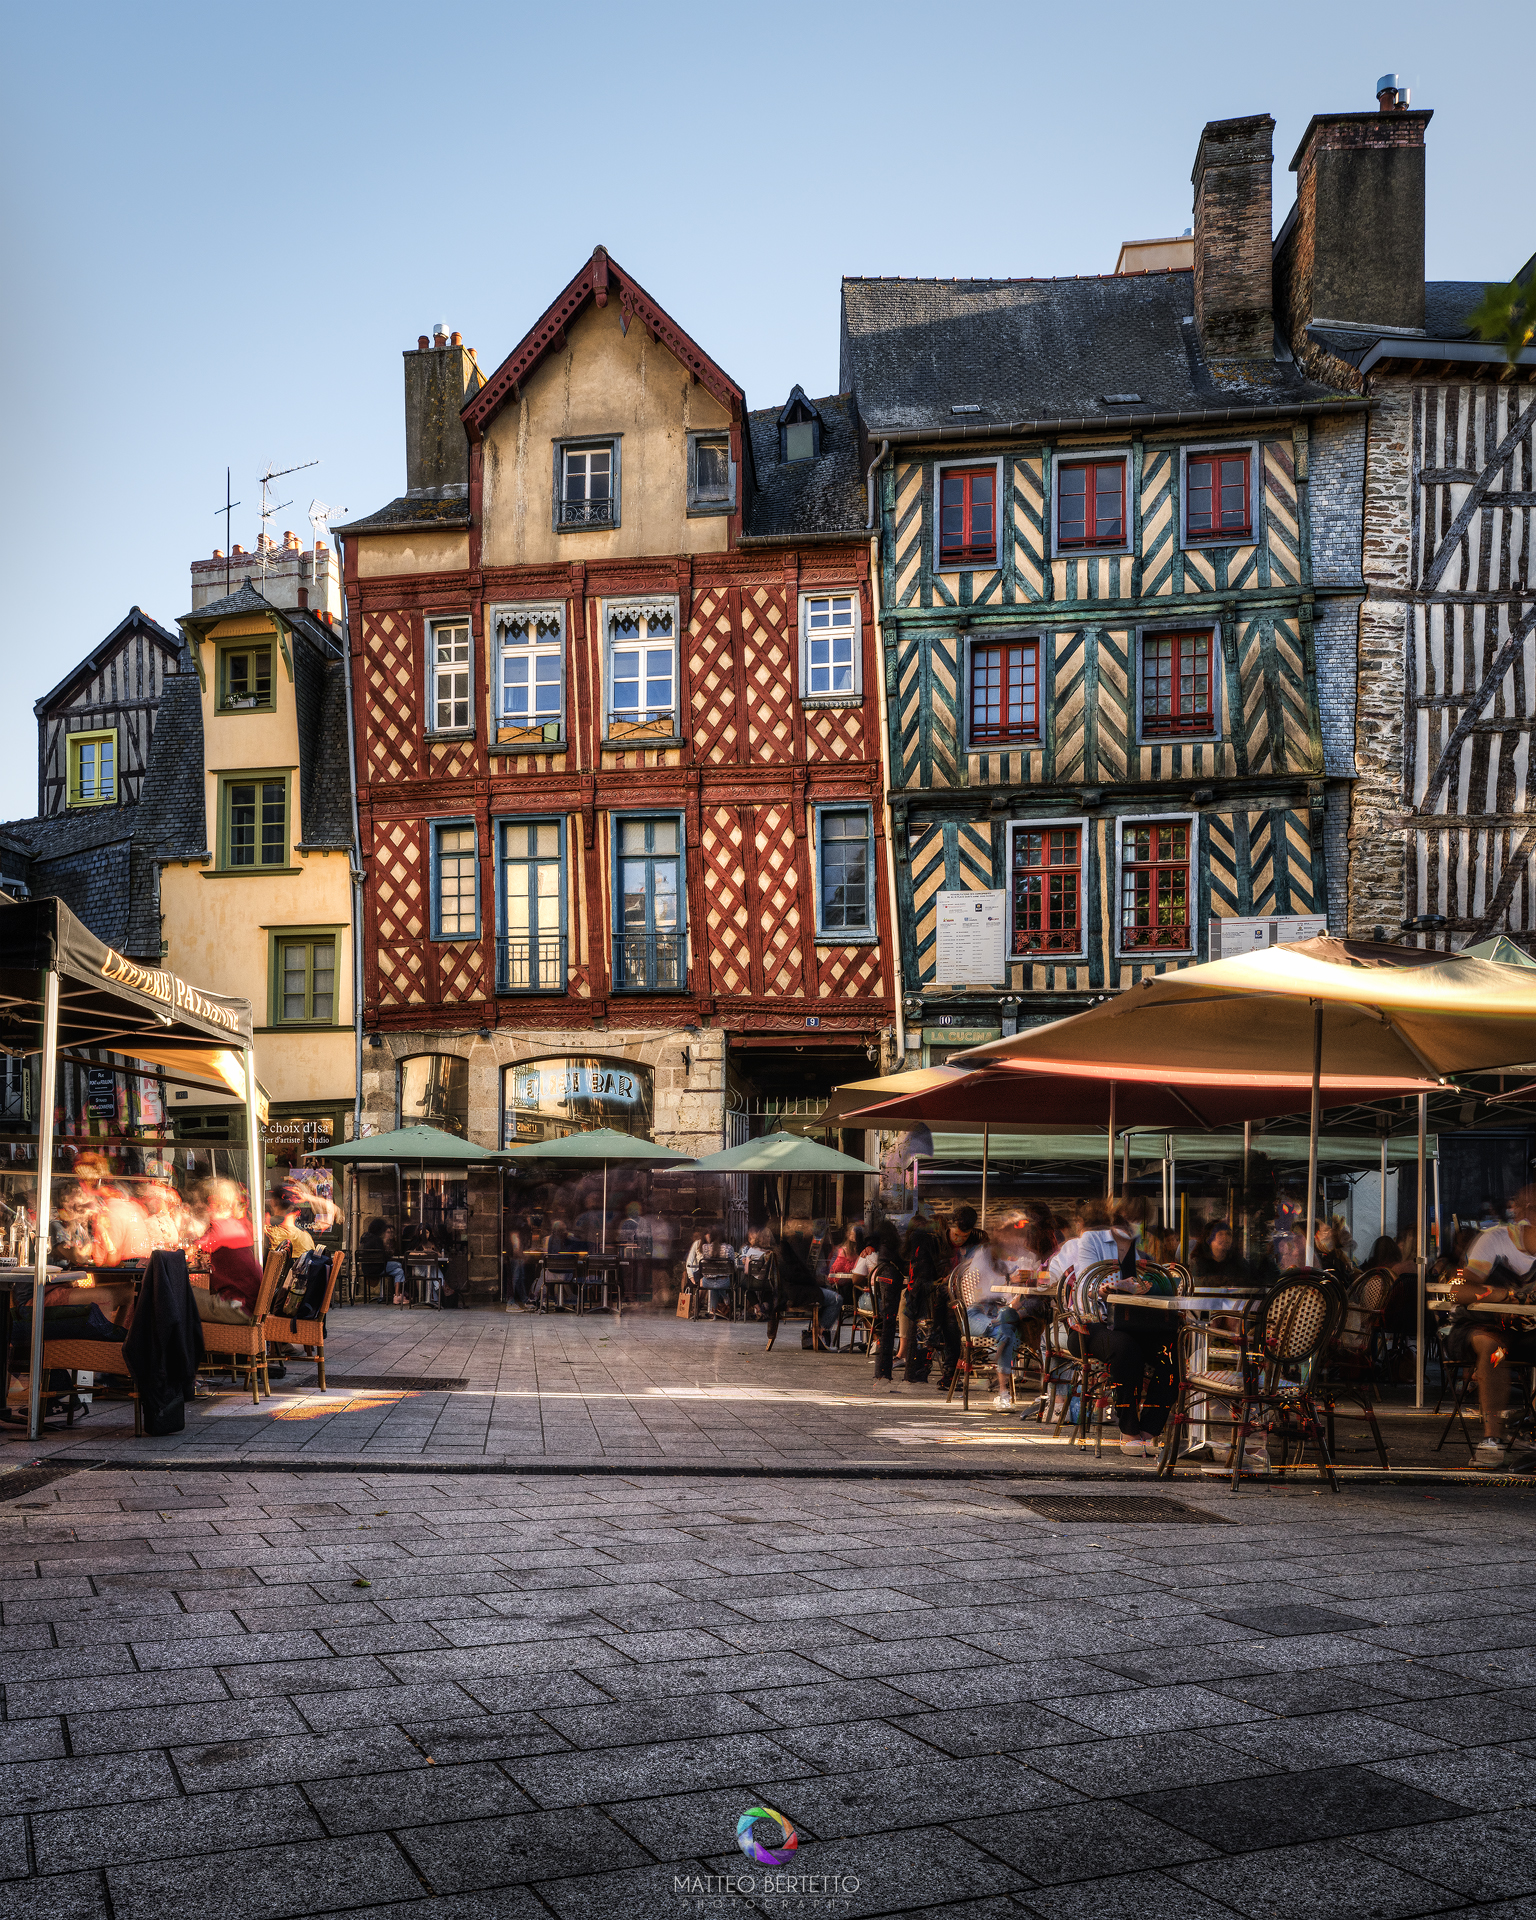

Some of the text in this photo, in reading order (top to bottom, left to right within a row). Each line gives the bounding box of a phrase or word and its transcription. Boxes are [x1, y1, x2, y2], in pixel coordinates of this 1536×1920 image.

[175, 978, 239, 1031] PAYSANNE
[940, 1016, 952, 1025] 10
[931, 1031, 994, 1041] LA CUCINA
[526, 1072, 633, 1098] CUCI BAR
[270, 1122, 300, 1133] choix
[303, 1122, 328, 1133] d'Isa
